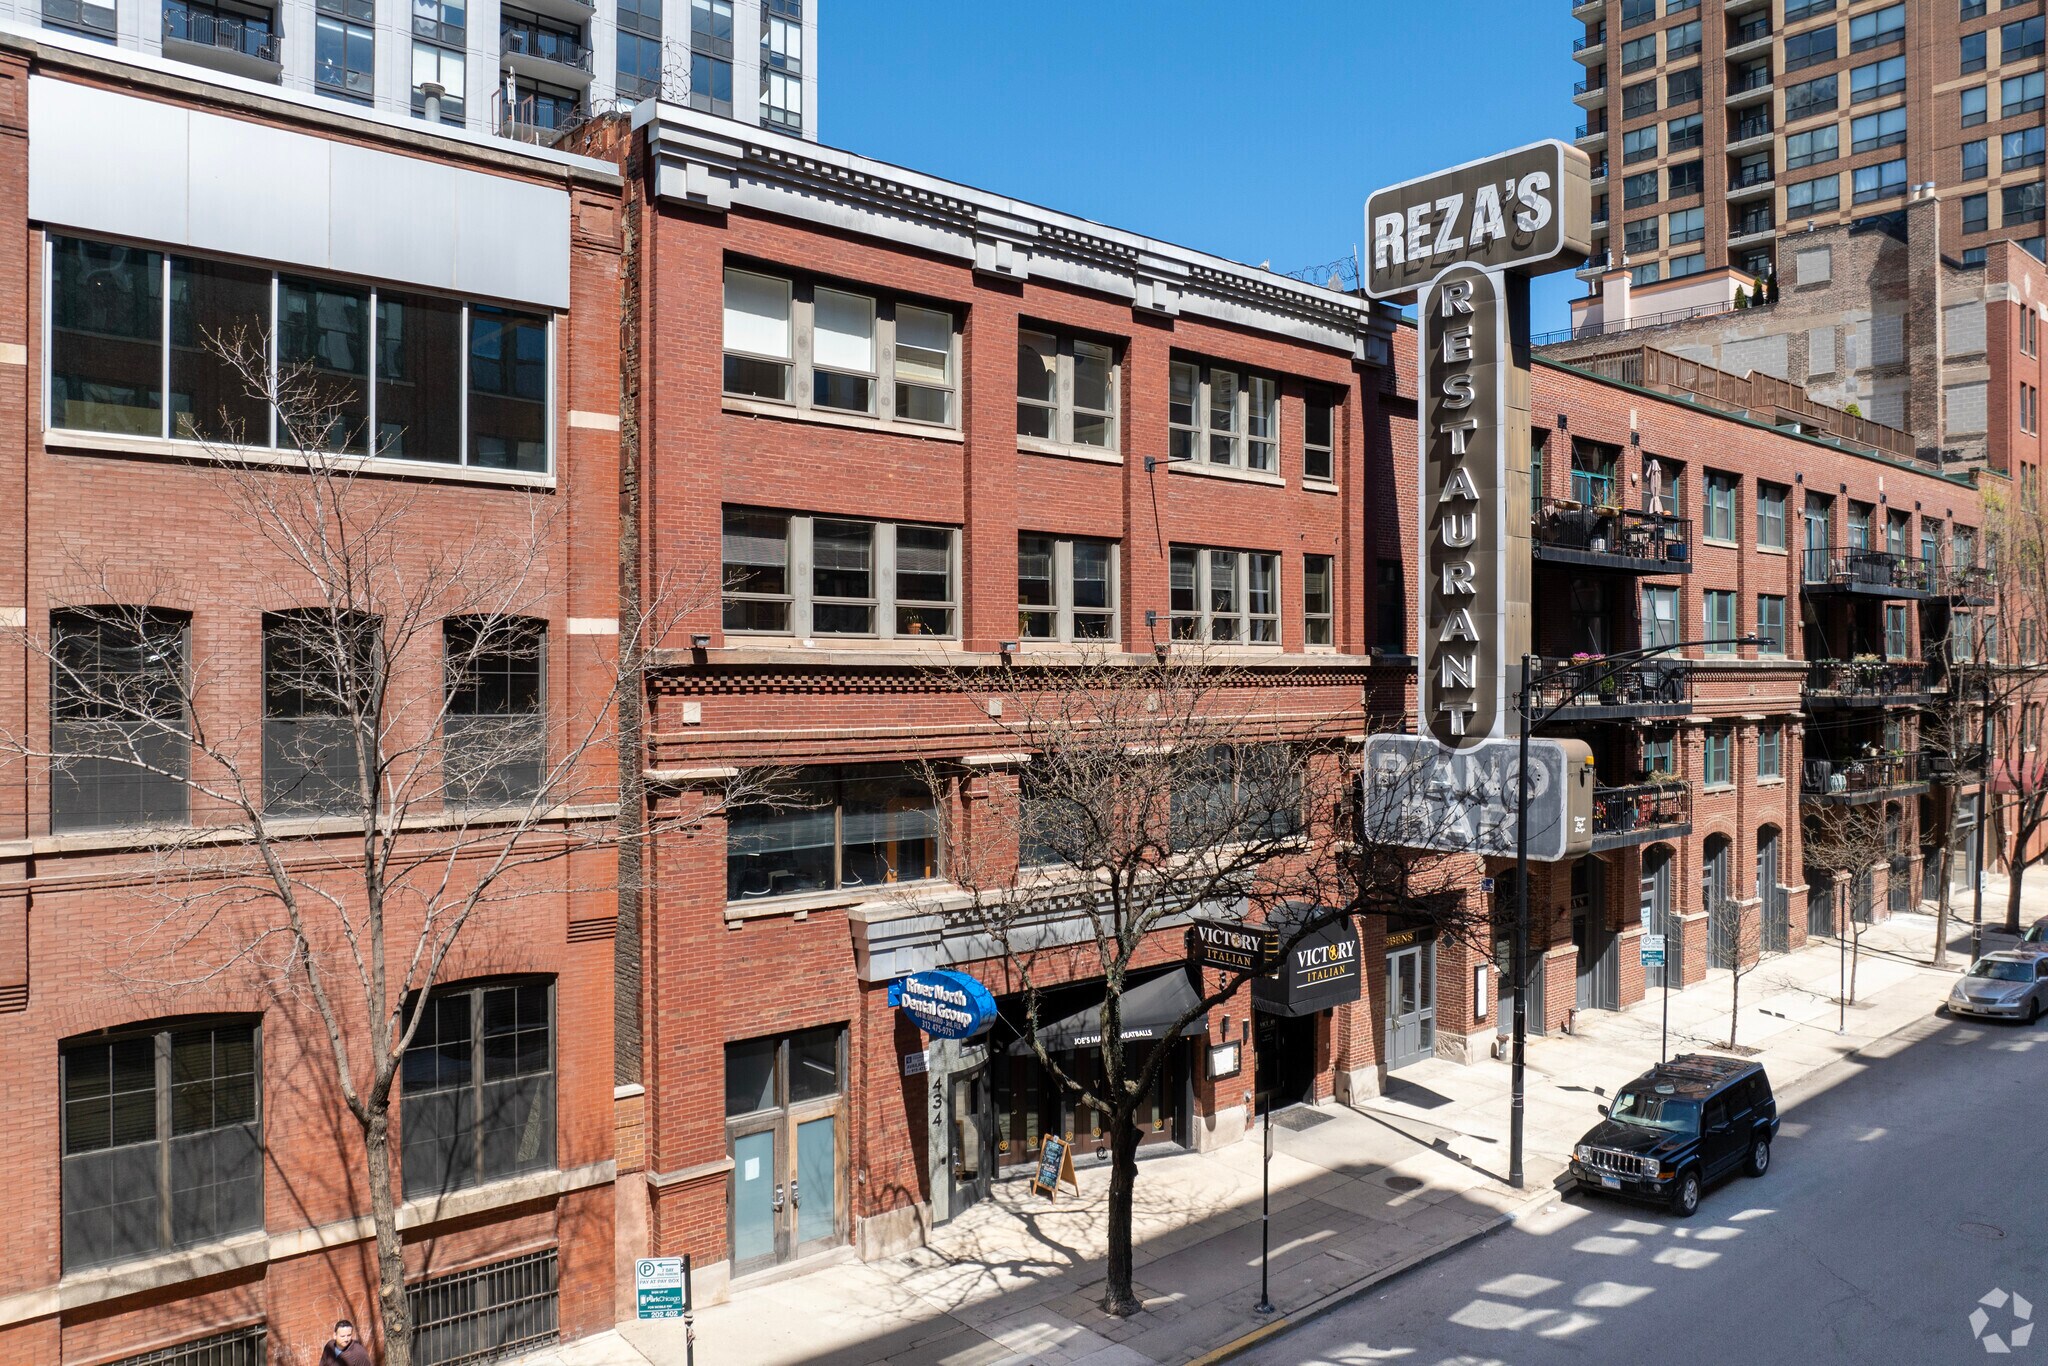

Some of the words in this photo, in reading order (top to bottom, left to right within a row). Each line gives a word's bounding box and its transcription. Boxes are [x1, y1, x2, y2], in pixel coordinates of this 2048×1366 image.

[1375, 171, 1552, 270] REZA'S
[1439, 280, 1480, 736] RESTAURANT
[1377, 752, 1550, 798] PIANO
[1198, 926, 1261, 952] VICTORY
[1207, 949, 1251, 967] ITALIAN
[1297, 940, 1355, 968] VICTORY
[1307, 965, 1346, 982] ITALIAN
[906, 977, 935, 997] River
[934, 984, 967, 1007] North
[901, 993, 937, 1016] Dental
[936, 1003, 973, 1028] Group
[921, 1020, 931, 1030] 312
[932, 1023, 955, 1037] 475-9751
[1074, 1036, 1091, 1046] JOE'S
[932, 1076, 943, 1127] 434
[644, 1264, 652, 1274] P
